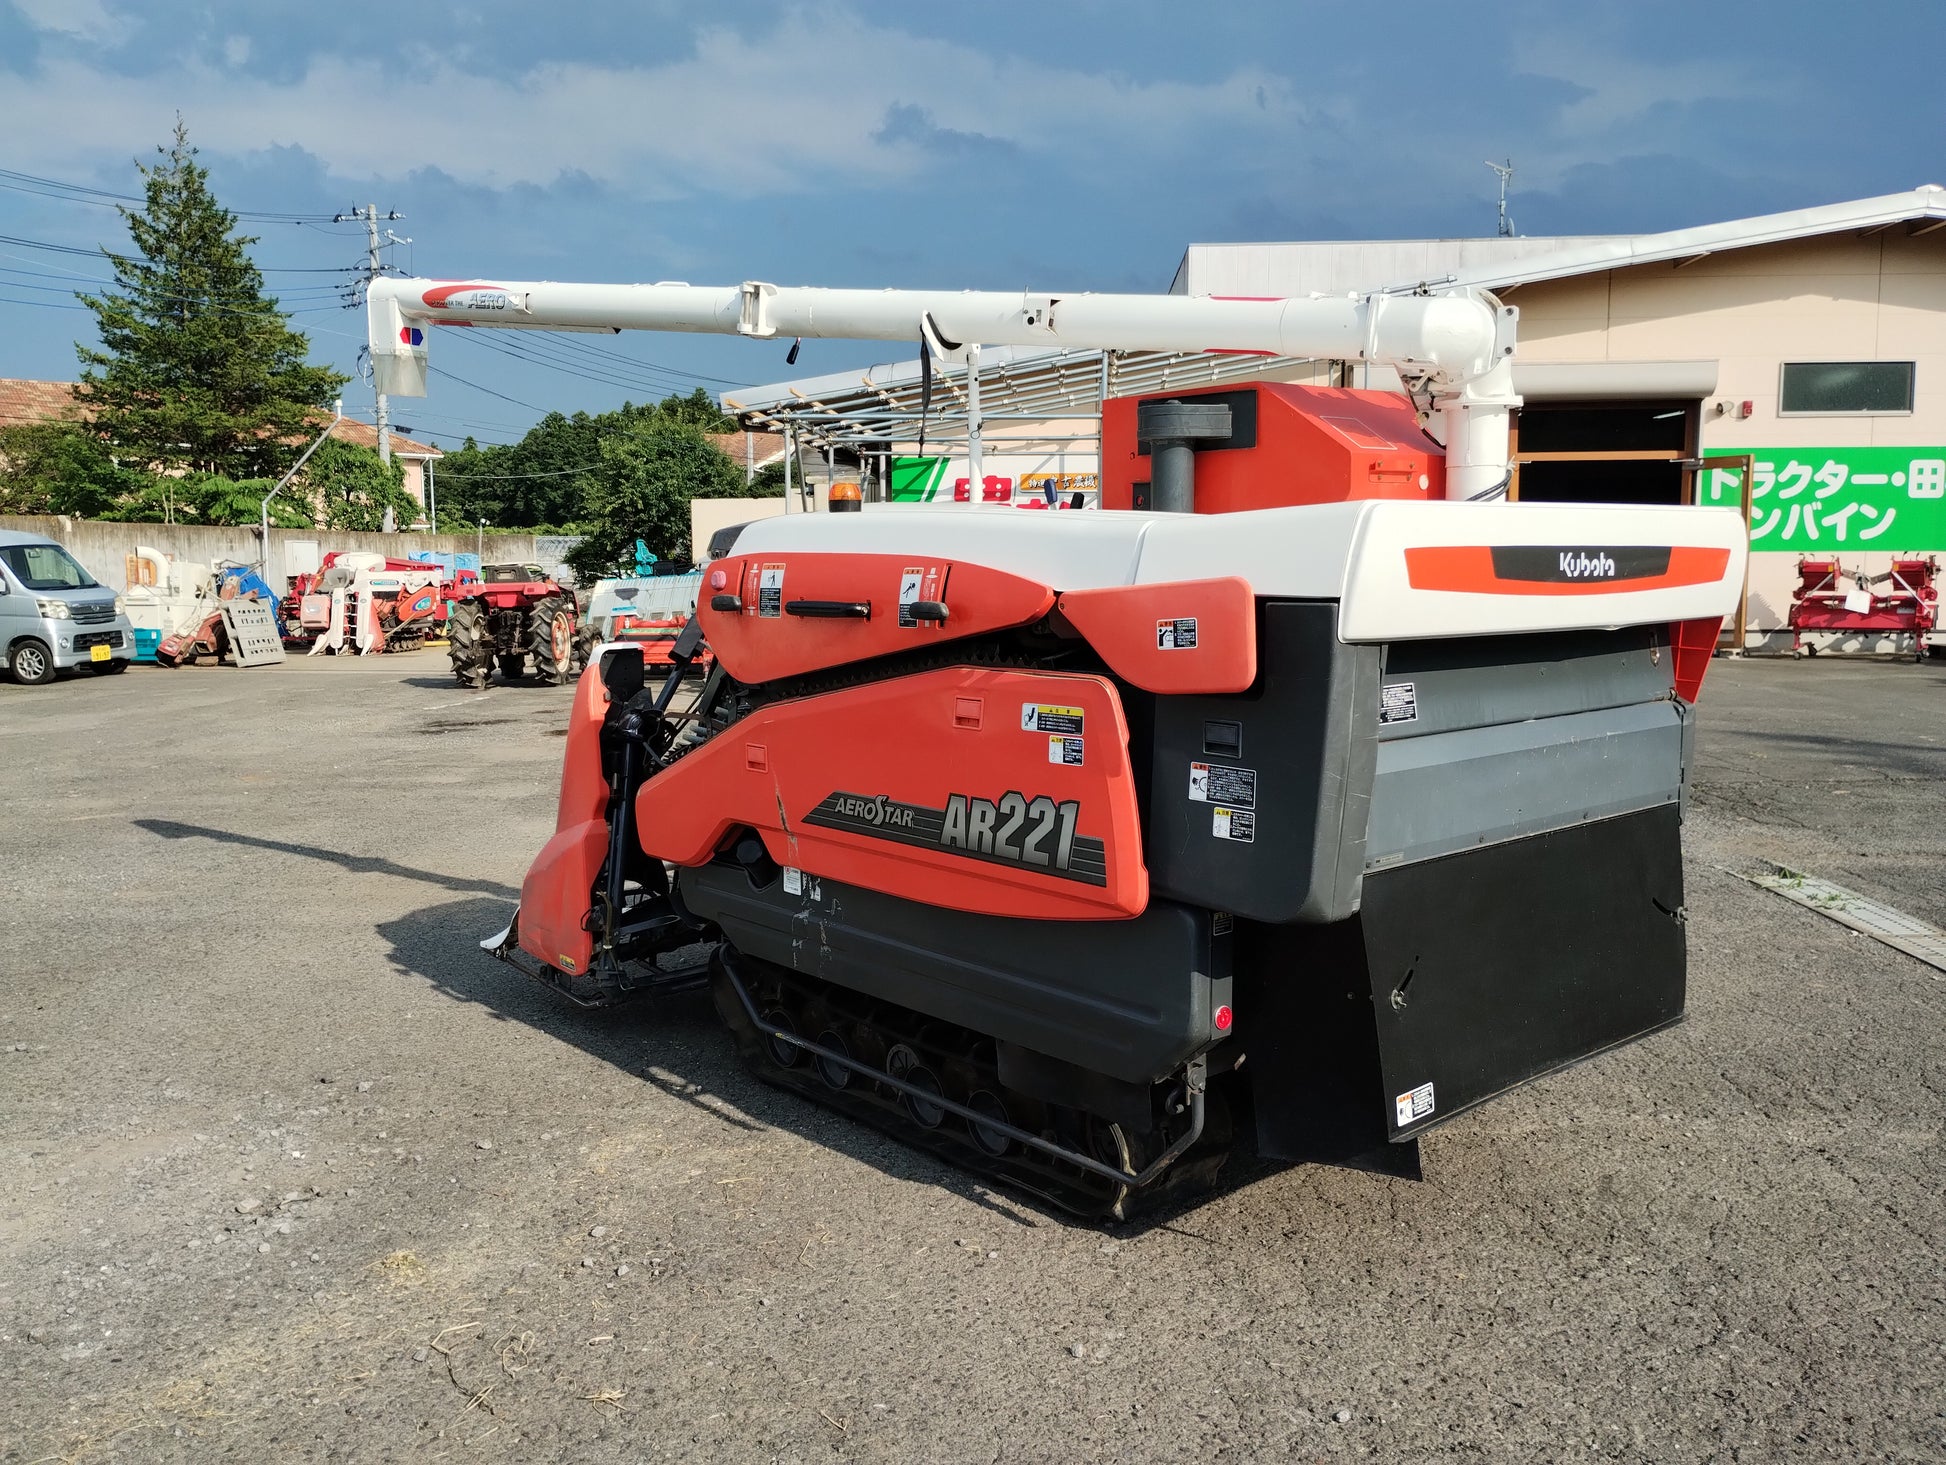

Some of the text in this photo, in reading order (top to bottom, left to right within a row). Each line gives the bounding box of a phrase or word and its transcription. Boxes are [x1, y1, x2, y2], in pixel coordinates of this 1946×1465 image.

[467, 292, 507, 310] AERO
[1559, 551, 1616, 578] Kubota
[939, 790, 1081, 872] AR221
